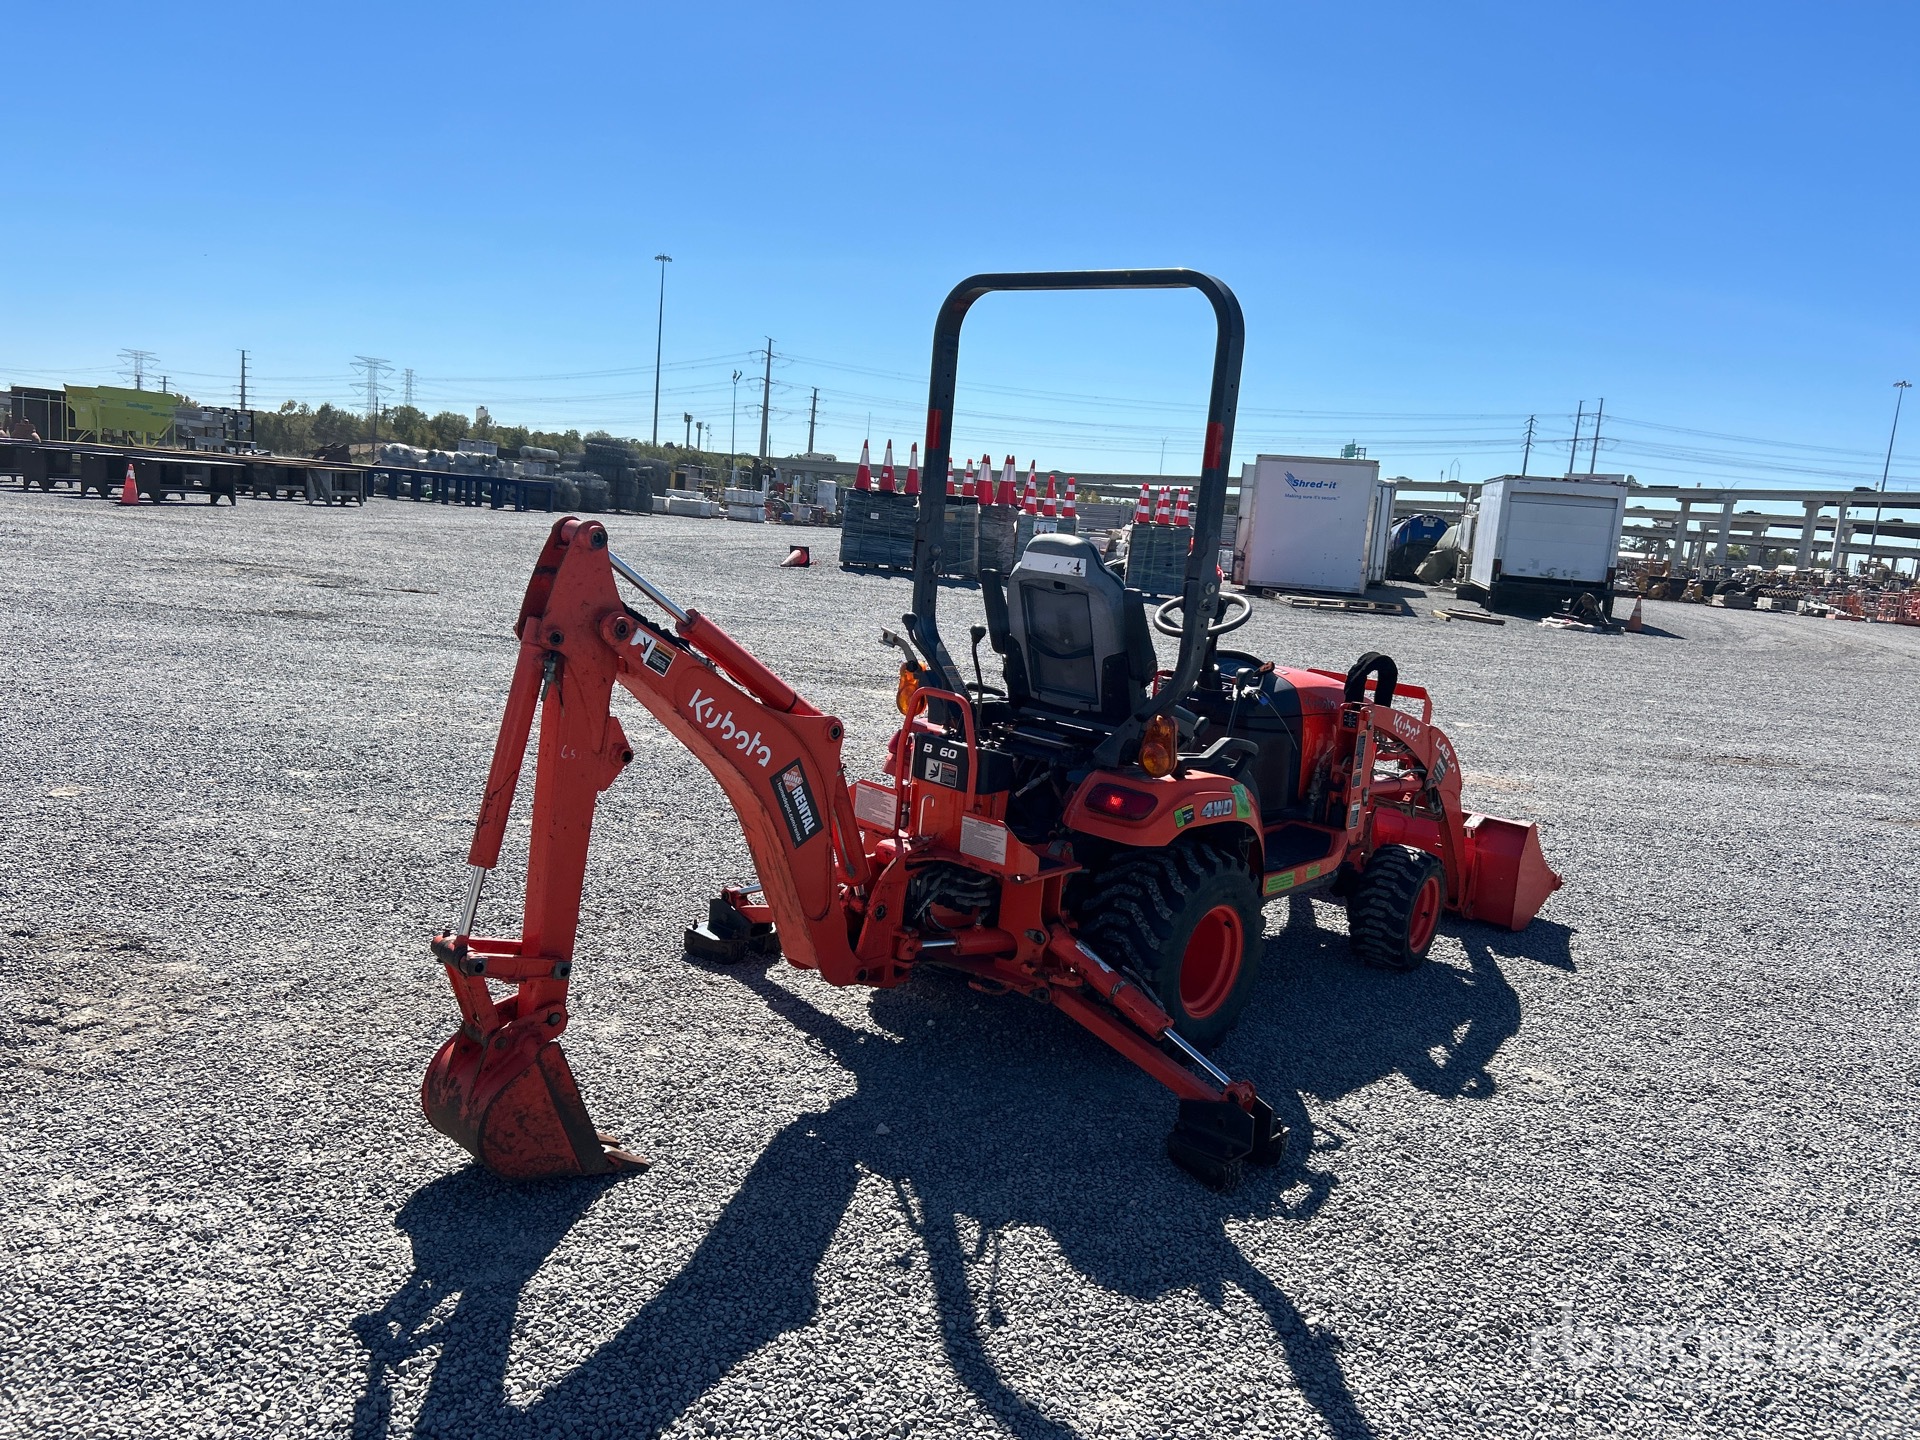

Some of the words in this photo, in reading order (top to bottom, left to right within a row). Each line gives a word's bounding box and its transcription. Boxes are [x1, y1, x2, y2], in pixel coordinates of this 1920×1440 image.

[1292, 479, 1337, 489] Shred-it
[688, 688, 771, 768] Kubota
[777, 781, 802, 842] homedepot.com/rental
[791, 785, 816, 835] RENTAL
[1201, 798, 1233, 818] 4WD
